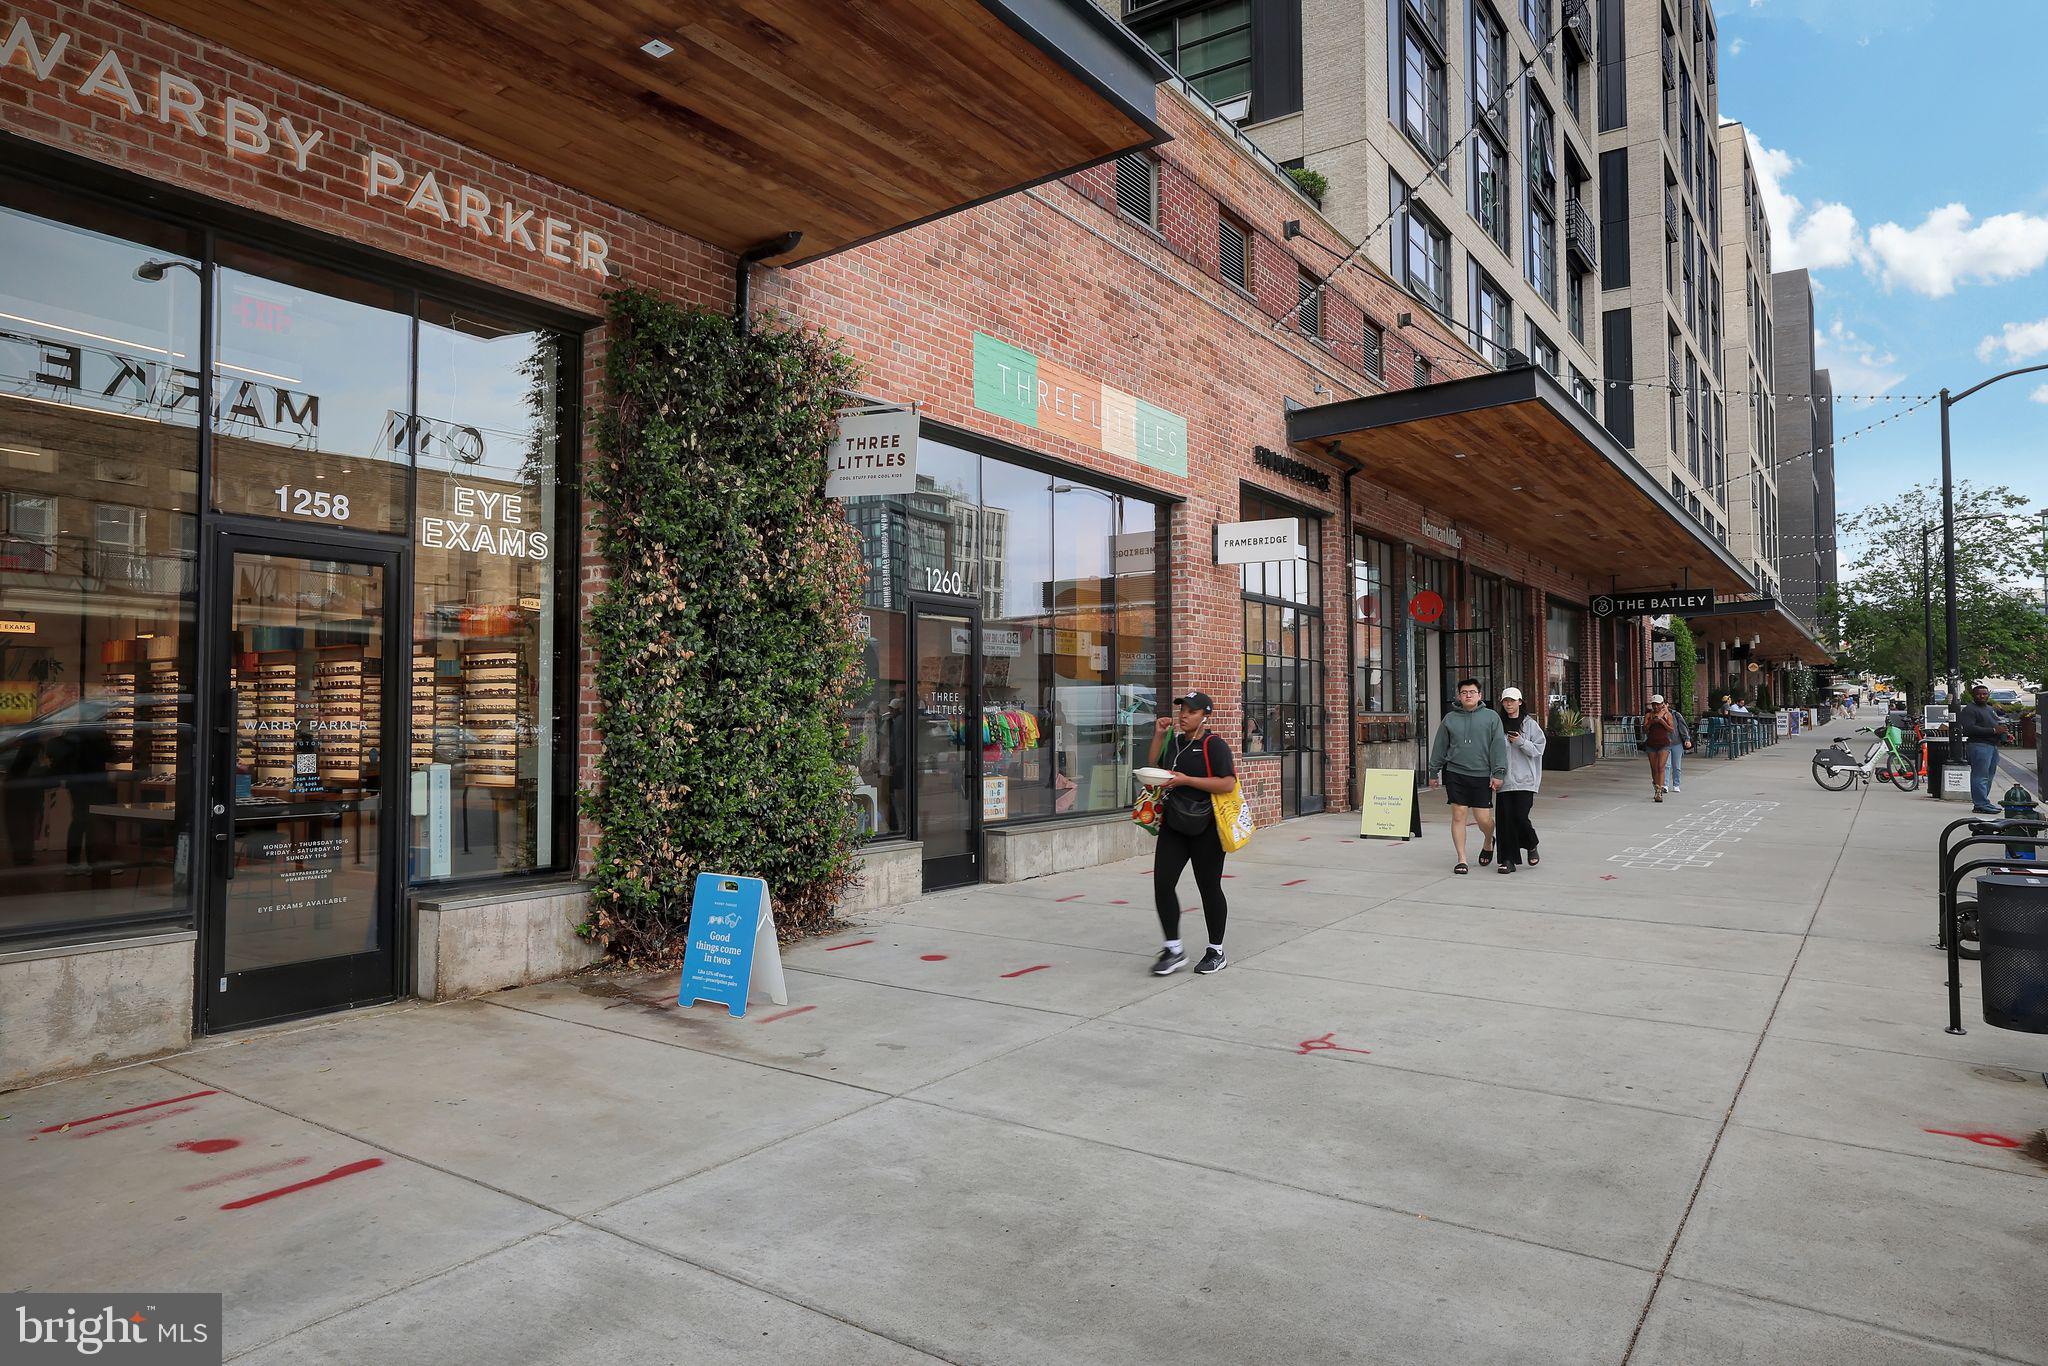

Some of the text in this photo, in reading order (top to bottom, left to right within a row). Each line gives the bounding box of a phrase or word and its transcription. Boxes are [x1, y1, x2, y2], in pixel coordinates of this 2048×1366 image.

[0, 16, 610, 277] WARBY PARKER
[997, 363, 1178, 457] THREE LITTLES
[846, 434, 900, 451] THREE
[837, 452, 906, 470] LITTLES
[275, 485, 351, 521] 1258
[454, 486, 522, 524] EYE
[422, 517, 549, 560] EXAMS
[1224, 535, 1288, 548] FRAMEBRIDGE
[925, 566, 961, 595] 1260
[1617, 599, 1645, 610] THE
[1651, 595, 1707, 609] BATLEY
[931, 691, 960, 702] THREE
[927, 705, 963, 715] LITTLES
[244, 720, 368, 731] WARBY PARKER
[263, 842, 292, 850] MONDAY
[299, 839, 334, 847] THURSDAY
[265, 849, 290, 857] FRIDAY
[297, 846, 331, 854] SATURDAY
[286, 854, 313, 862] SUNDAY
[280, 868, 333, 878] WARBYPARKER.COM
[257, 896, 348, 914] EYE EXAMS AVAILABLE
[709, 930, 731, 943] Good
[695, 940, 742, 956] things come
[703, 952, 731, 966] in twos
